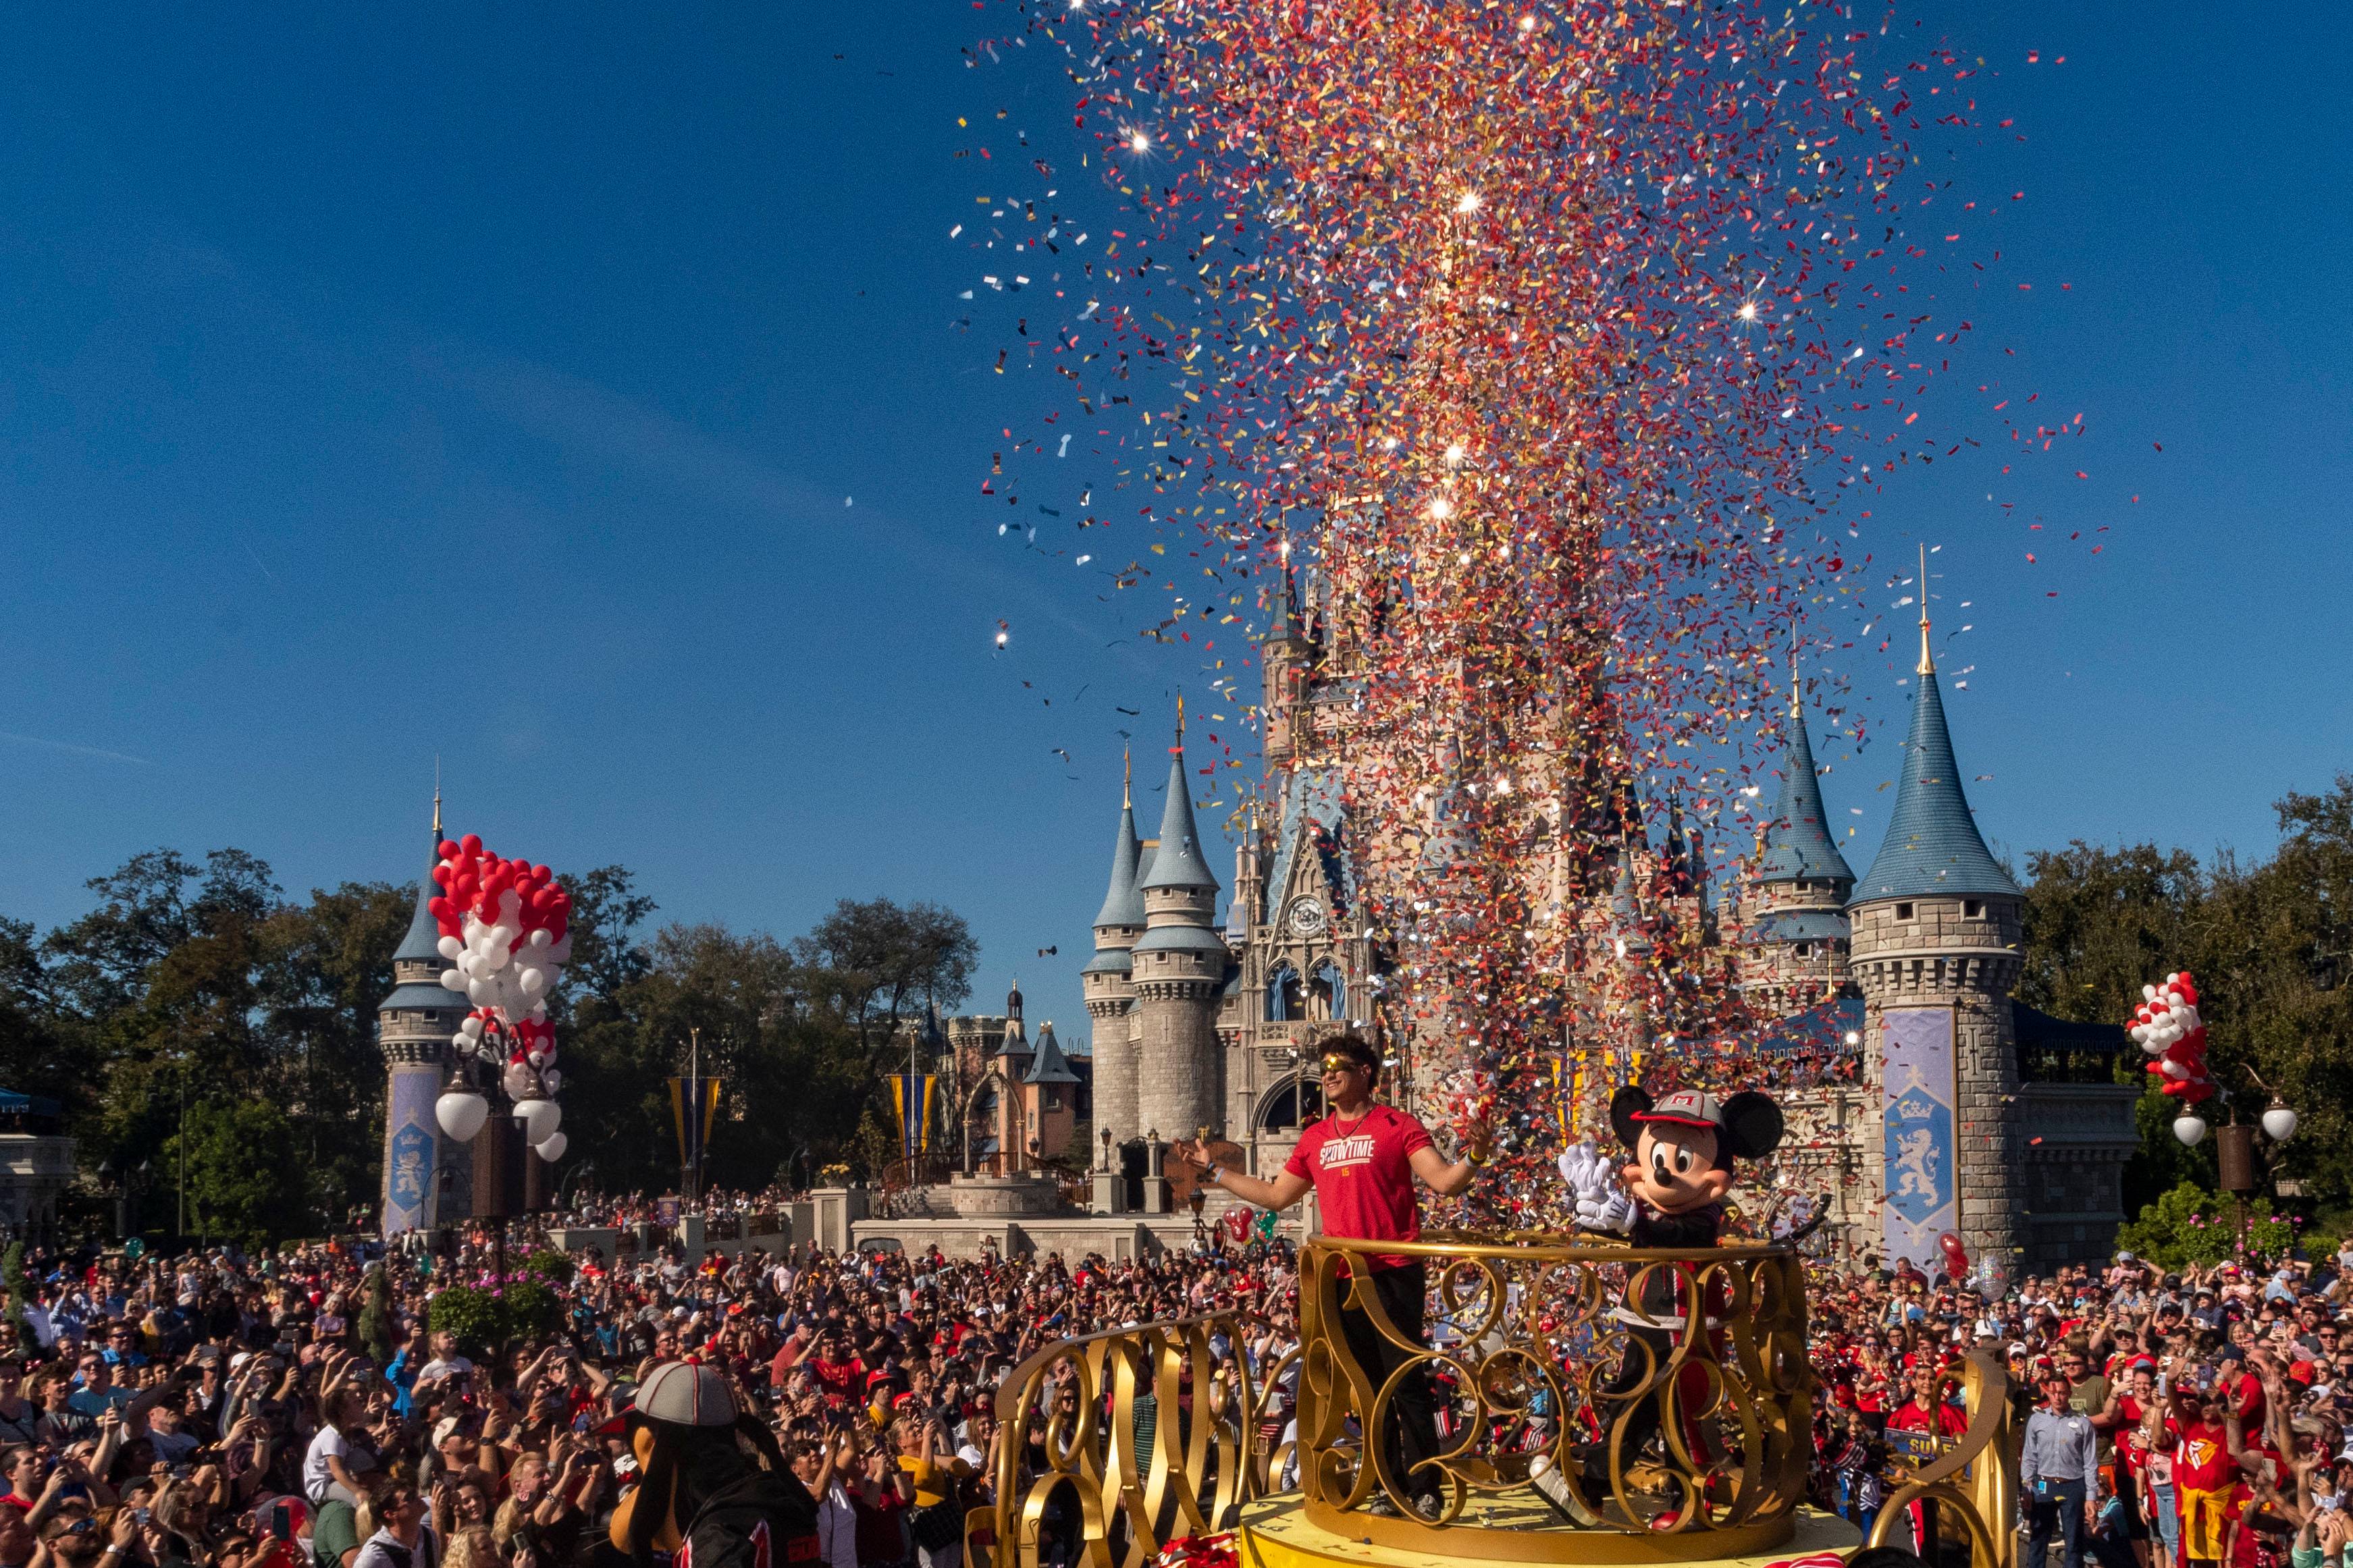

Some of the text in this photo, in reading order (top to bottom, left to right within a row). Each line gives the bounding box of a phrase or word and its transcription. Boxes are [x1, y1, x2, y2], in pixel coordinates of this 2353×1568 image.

[1670, 1095, 1695, 1106] M
[1319, 1139, 1375, 1165] SHOWTIME
[1342, 1167, 1350, 1177] 15
[1909, 1438, 1956, 1454] SUE
